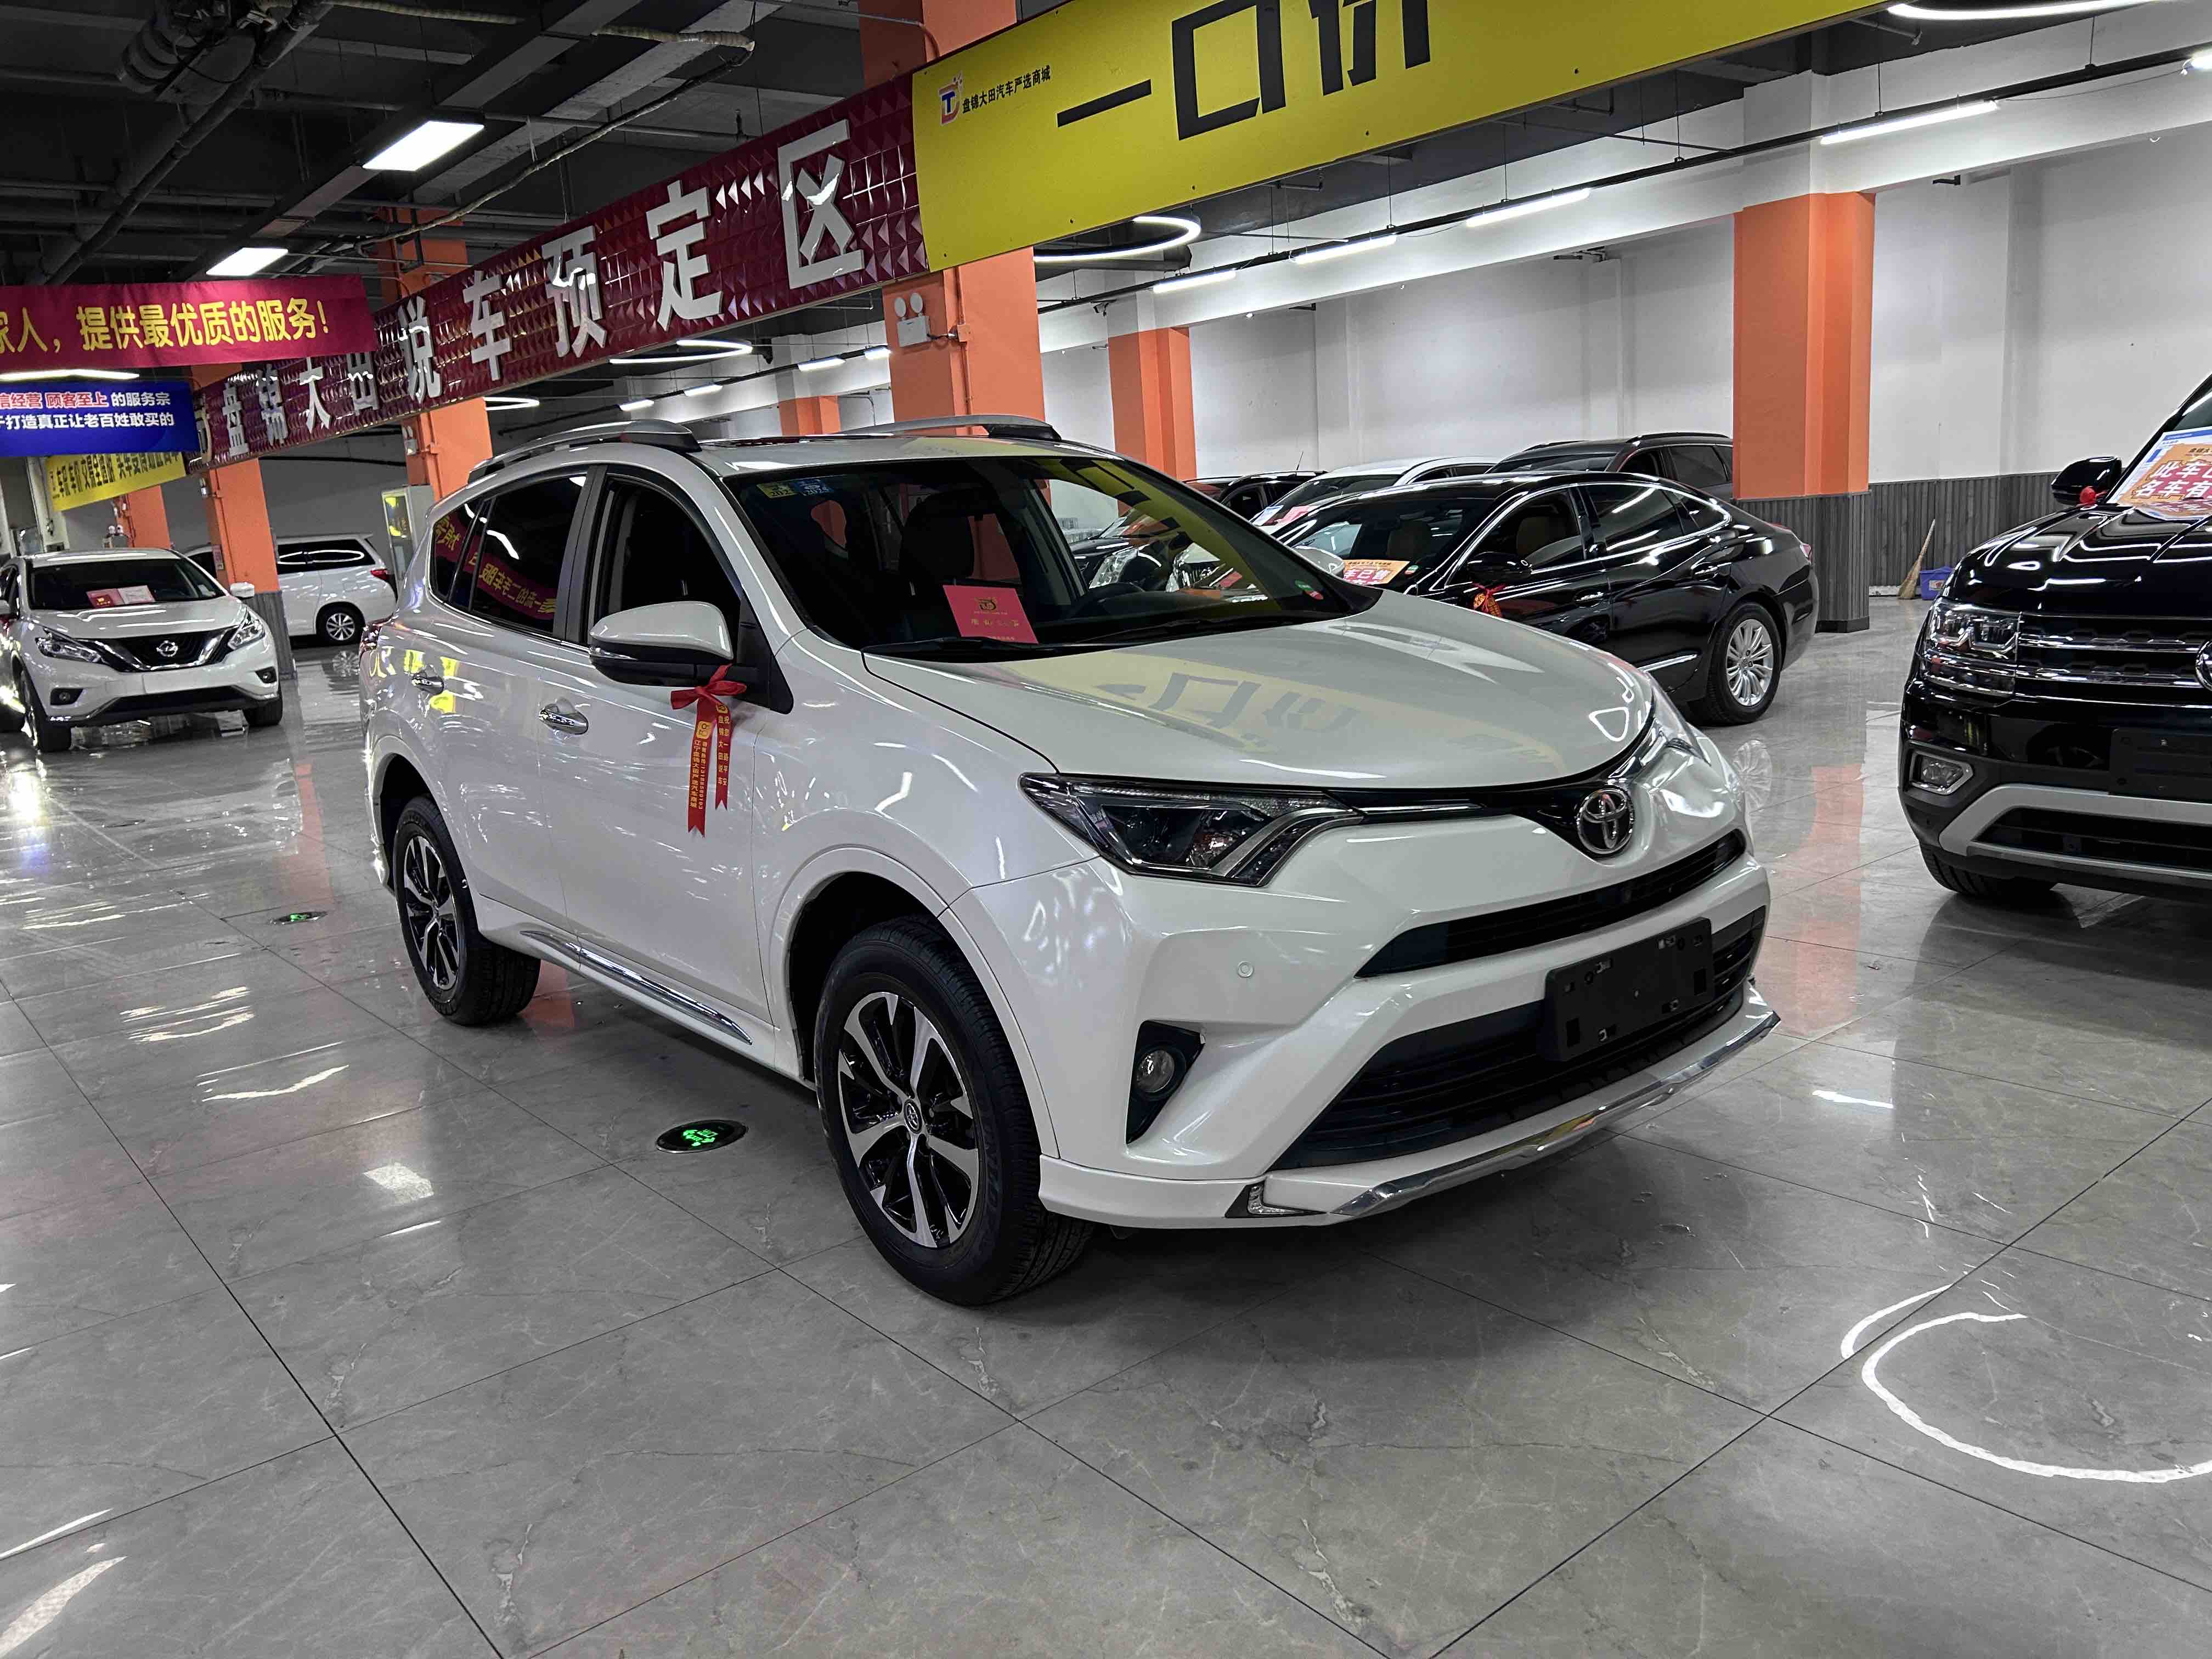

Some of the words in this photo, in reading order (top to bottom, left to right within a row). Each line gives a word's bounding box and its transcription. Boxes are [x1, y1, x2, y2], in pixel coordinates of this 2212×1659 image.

[962, 65, 1051, 114] 盘锦大田汽车严选商城
[44, 391, 109, 409] 顾客至上
[111, 392, 171, 407] 的服务宗
[2136, 479, 2212, 499] 名车有
